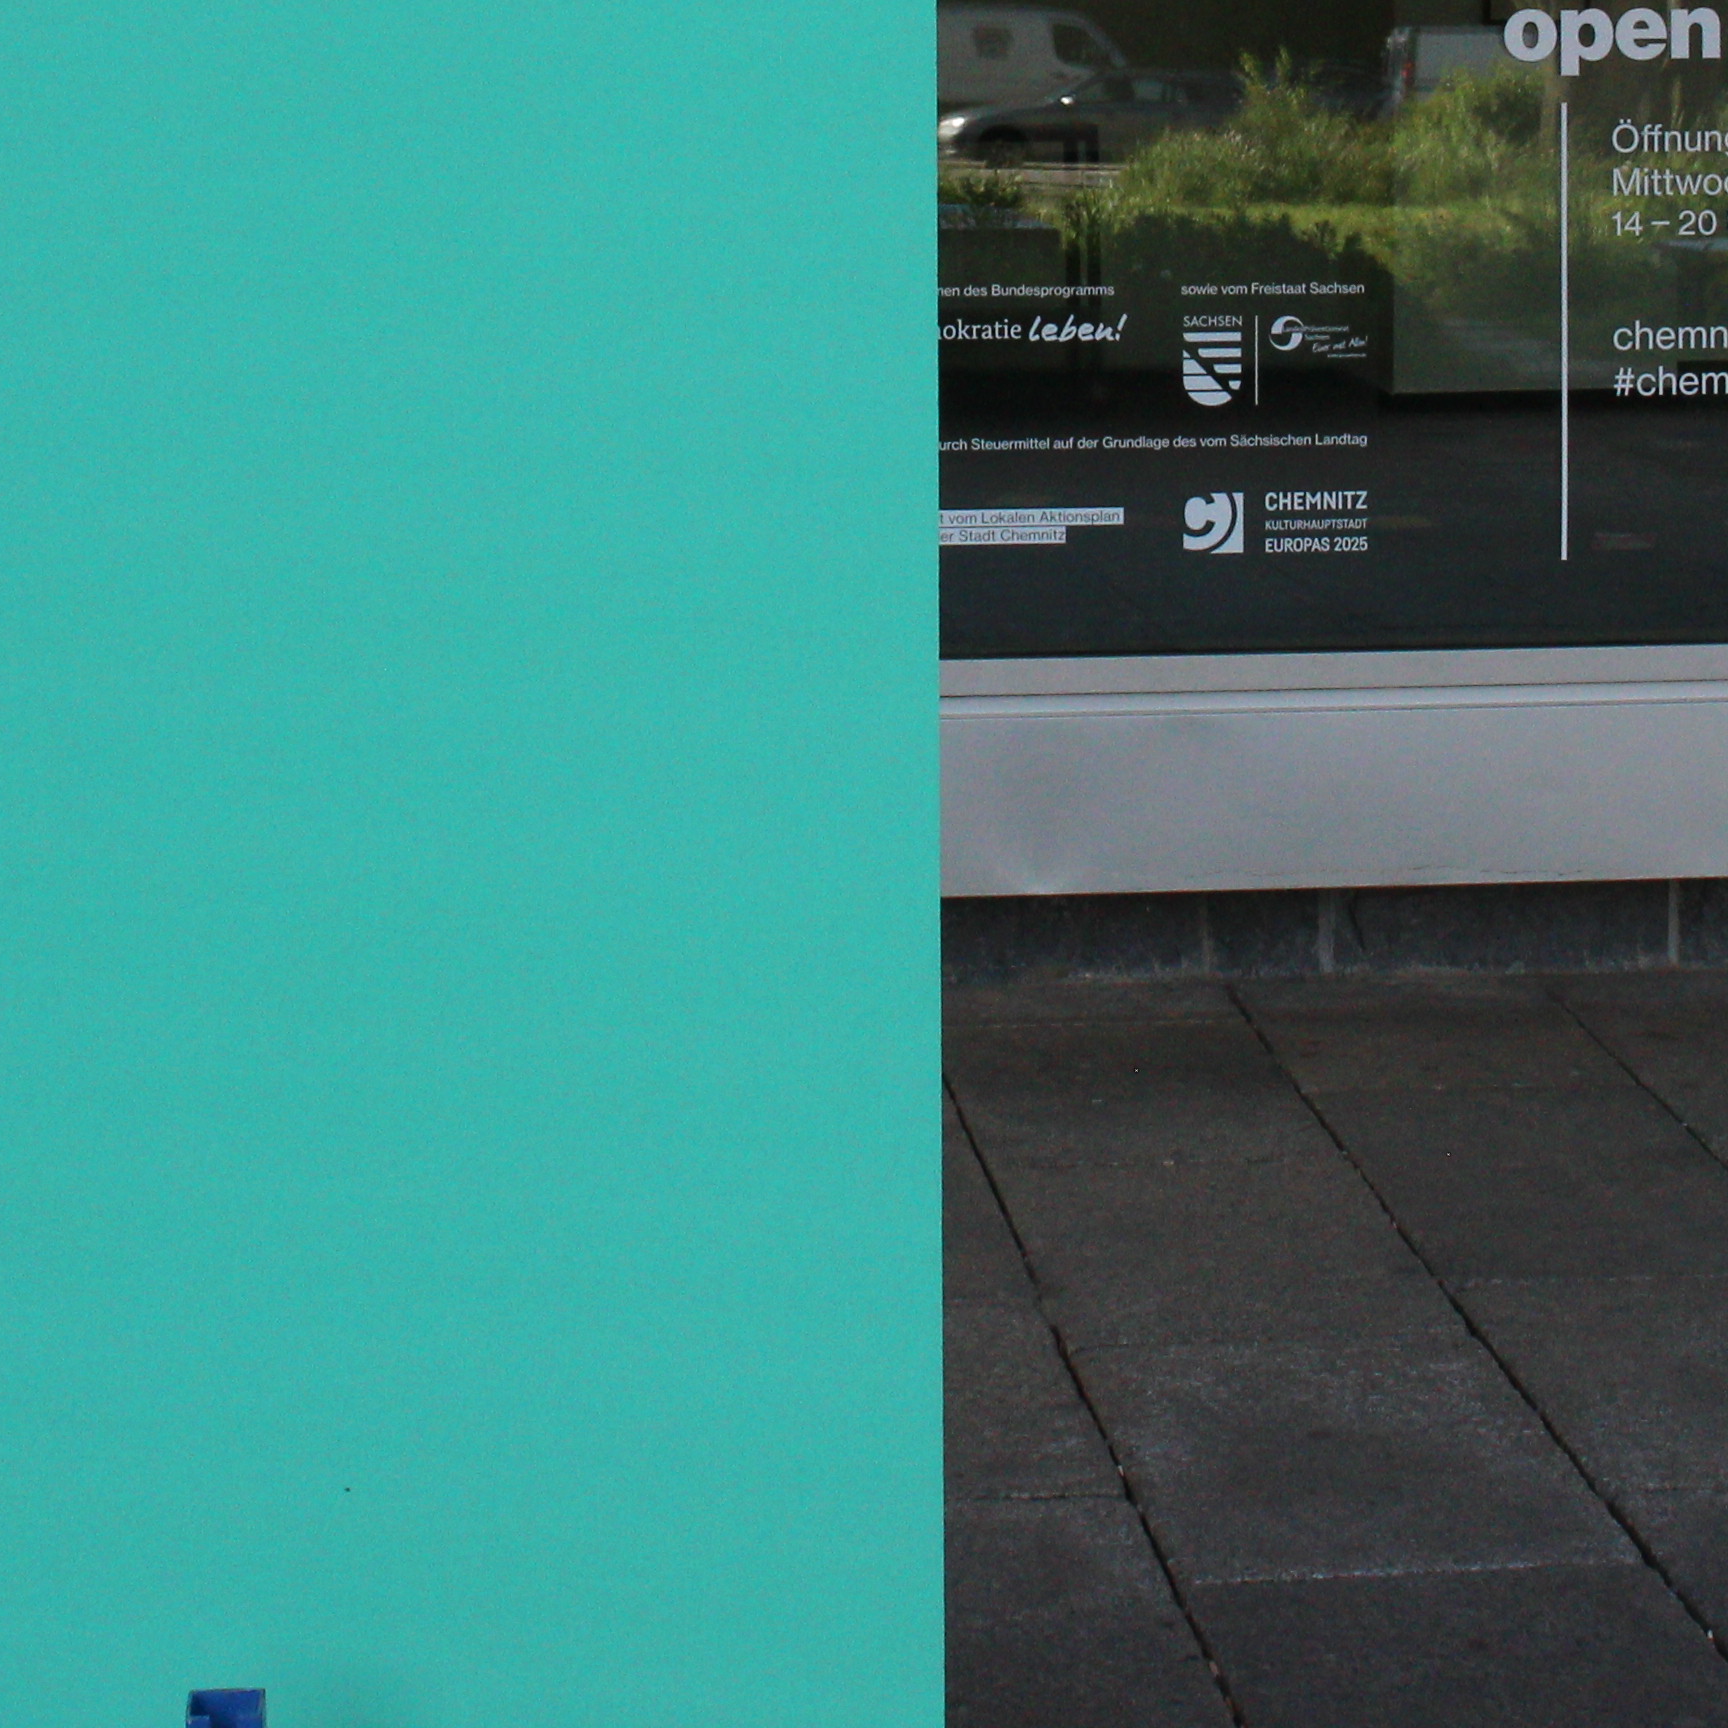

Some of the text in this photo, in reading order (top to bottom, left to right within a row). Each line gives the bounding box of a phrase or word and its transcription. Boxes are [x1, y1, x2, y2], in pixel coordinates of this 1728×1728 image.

[1503, 8, 1720, 76] open
[1612, 211, 1643, 236] 14
[1679, 210, 1717, 235] 20
[964, 284, 1114, 298] des Bundesprogramms
[1181, 282, 1365, 294] sowie vom Freistaat Sachsen
[1183, 315, 1242, 327] SACHSEN
[938, 319, 1022, 339] okratie
[971, 438, 1050, 450] Steuermittel
[1054, 437, 1074, 449] auf
[1077, 437, 1098, 448] der
[1103, 437, 1169, 450] Grundlage
[1173, 436, 1197, 447] des
[1200, 438, 1227, 447] vom
[1230, 434, 1312, 447] Sächsischen
[1315, 434, 1368, 448] Landtag
[1265, 491, 1368, 510] CHEMNITZ
[949, 510, 1120, 525] vom Lokalen Aktionsplan
[1265, 519, 1367, 531] KULTURHAUPTSTADT
[959, 529, 1065, 541] Stadt Chemnitz
[1265, 536, 1368, 552] EUROPAS 2025
